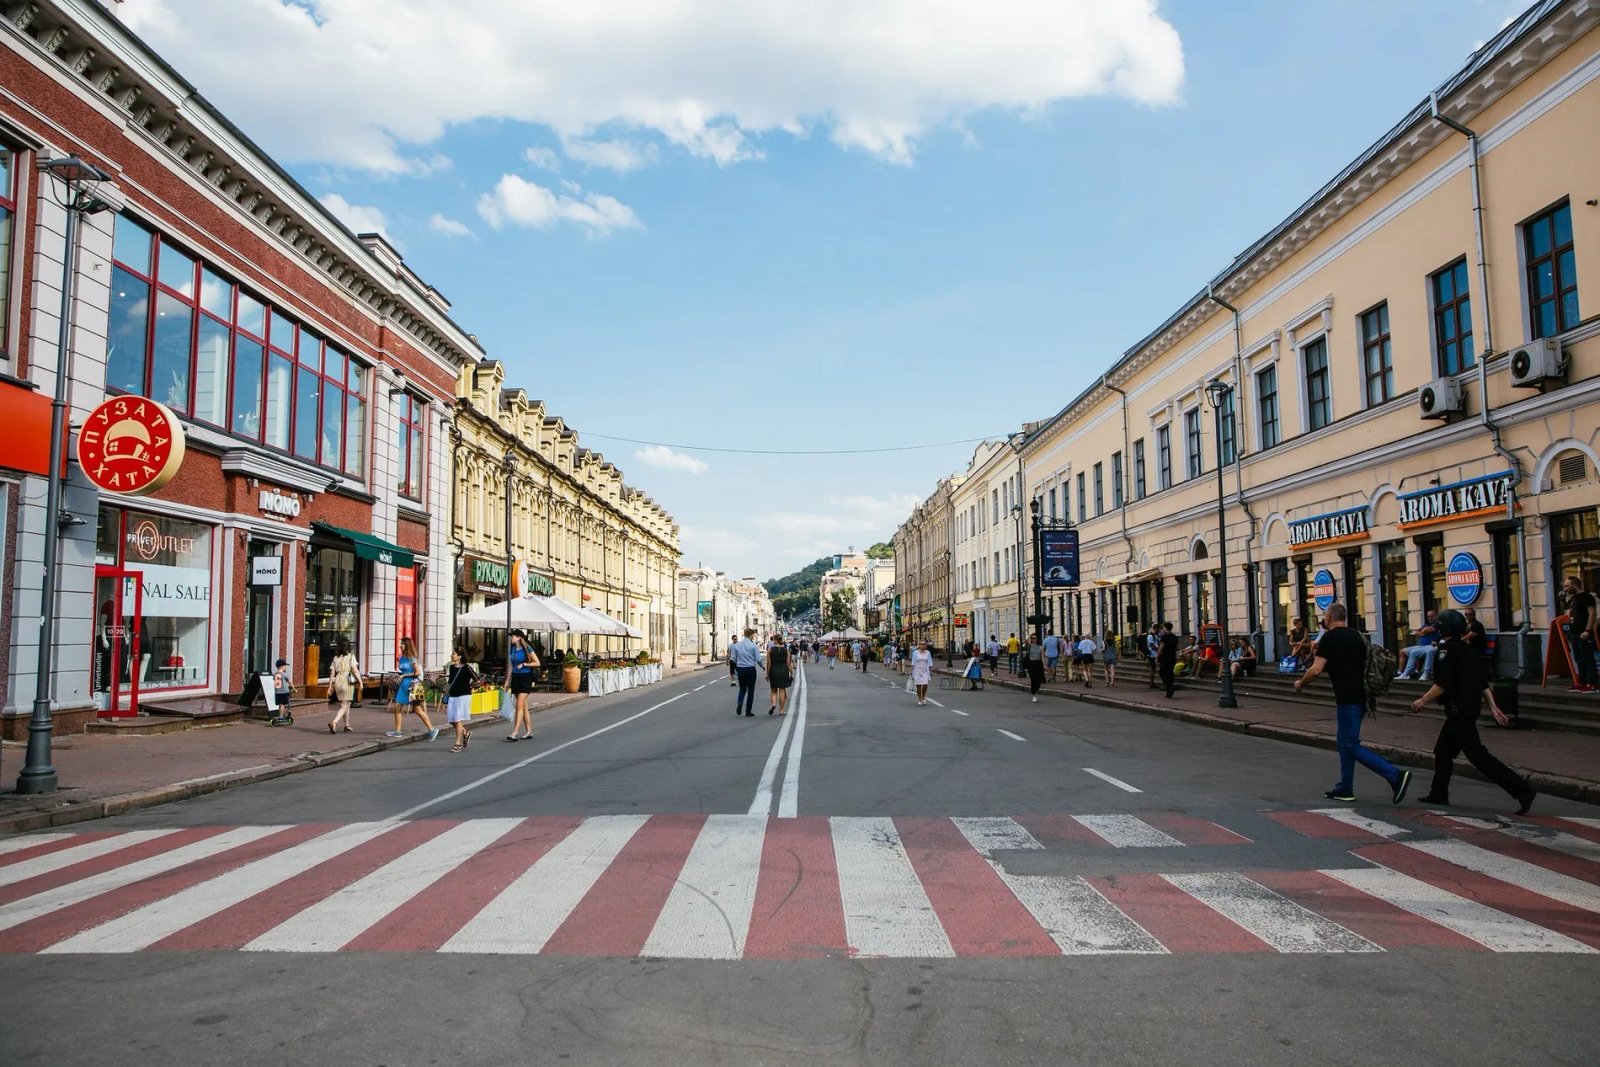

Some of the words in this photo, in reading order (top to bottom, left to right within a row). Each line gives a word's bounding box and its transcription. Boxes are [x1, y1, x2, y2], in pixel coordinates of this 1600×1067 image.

[84, 401, 169, 448] ПУЗАТА
[92, 462, 156, 487] ХАТА
[1398, 490, 1456, 524] AROMA
[1460, 477, 1511, 512] KAVA
[1289, 519, 1328, 545] AROMA
[1331, 511, 1365, 537] KAVA
[125, 582, 172, 599] FNAL
[176, 585, 210, 601] SALE
